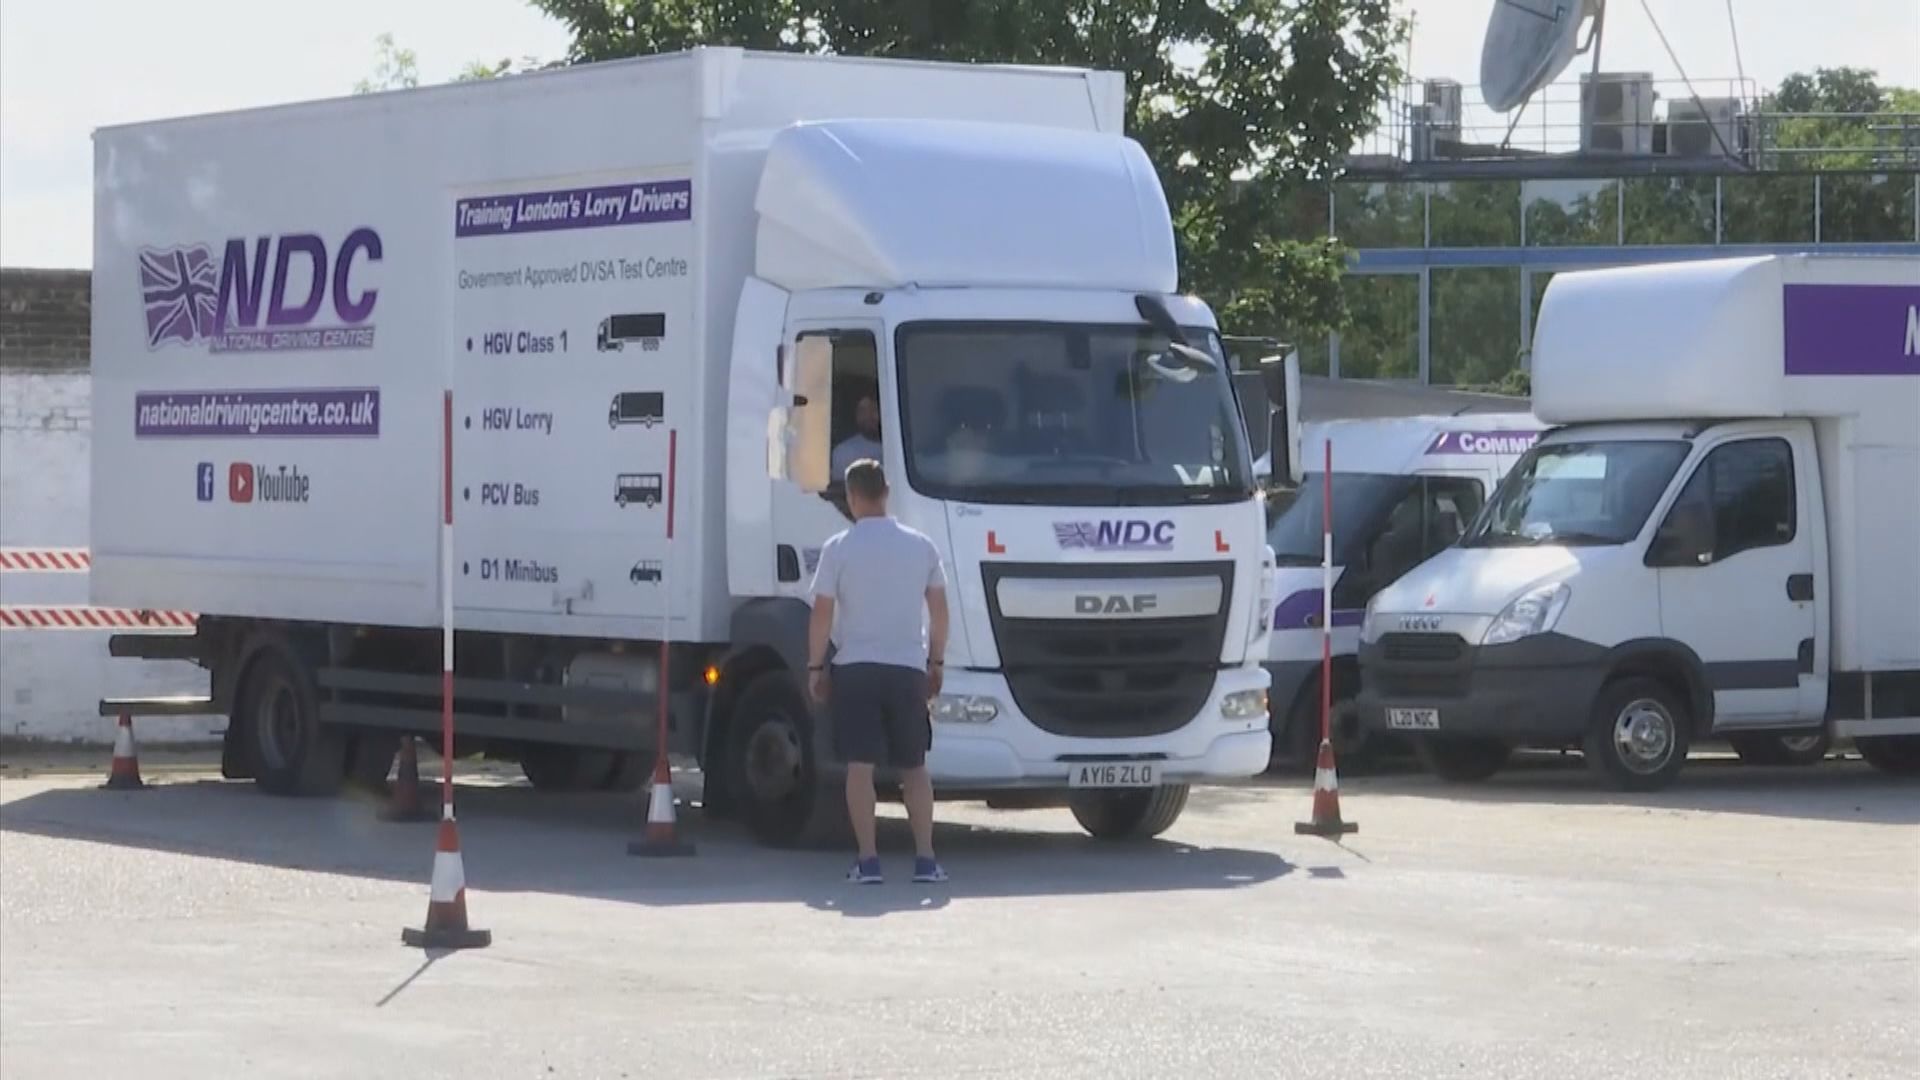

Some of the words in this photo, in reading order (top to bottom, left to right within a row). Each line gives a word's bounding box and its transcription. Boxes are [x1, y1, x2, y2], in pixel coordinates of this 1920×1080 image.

[459, 203, 514, 230] Training
[516, 197, 581, 223] London's
[584, 191, 627, 221] Lorry
[629, 188, 690, 214] Drivers
[213, 226, 383, 332] NDC
[458, 269, 522, 289] Government
[524, 264, 578, 288] Approved
[580, 260, 617, 283] DVSA
[618, 257, 643, 280] Test
[646, 256, 688, 279] Centre
[212, 333, 269, 350] NATIONAL
[271, 331, 321, 348] DRIVING
[323, 328, 374, 347] CENTRE
[484, 332, 513, 355] HGV
[517, 331, 555, 354] Class
[559, 329, 569, 353] 1
[139, 393, 375, 434] nationaldrivingcentre.co.uk
[482, 409, 512, 431] HGV
[516, 408, 553, 435] Lorry
[256, 465, 310, 503] YouTube
[481, 483, 510, 506] PCV
[514, 483, 540, 506] Bus
[987, 531, 1006, 554] L
[1097, 520, 1176, 547] NDC
[1215, 530, 1230, 552] L
[481, 558, 500, 581] D1
[505, 559, 559, 584] Minibus
[1075, 594, 1157, 614] DAF
[1080, 766, 1116, 785] AY16
[1120, 765, 1152, 784] ZLO
